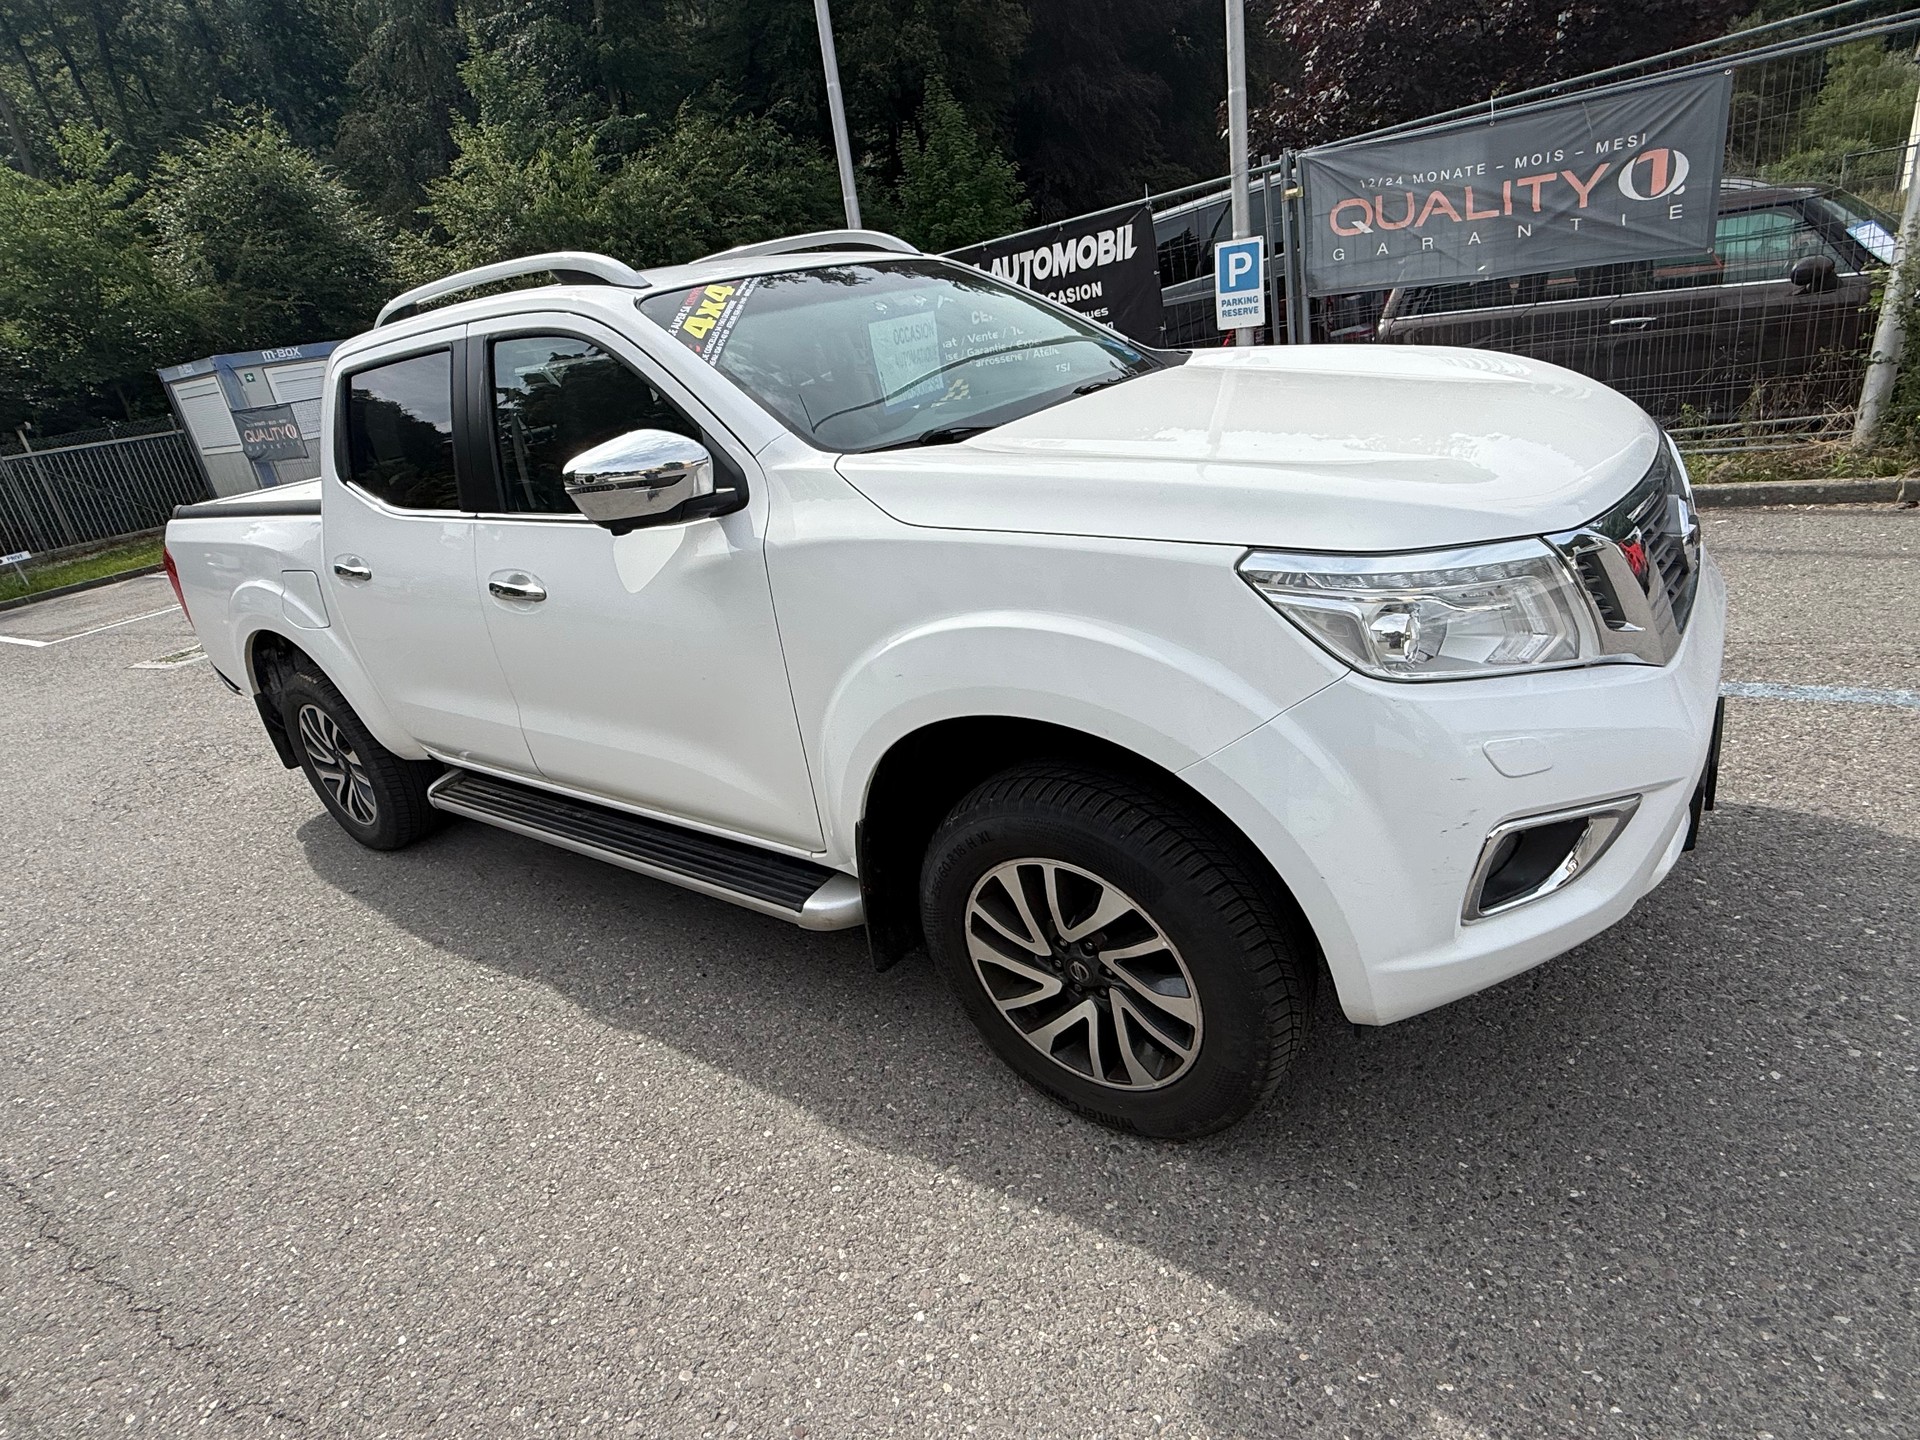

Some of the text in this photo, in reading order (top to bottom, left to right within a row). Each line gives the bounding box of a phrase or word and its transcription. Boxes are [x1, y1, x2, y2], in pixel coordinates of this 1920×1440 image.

[1360, 176, 1404, 188] 12/24
[1413, 163, 1486, 184] MONATE
[1515, 149, 1565, 169] MOIS
[1595, 133, 1647, 154] MESI
[1329, 162, 1611, 236] QUALITY
[1228, 251, 1252, 288] P
[1221, 296, 1259, 307] PARKING
[1222, 306, 1259, 318] RESERVE
[893, 322, 936, 346] OCCASION
[967, 331, 999, 343] Vente
[244, 426, 287, 443] QUALITY
